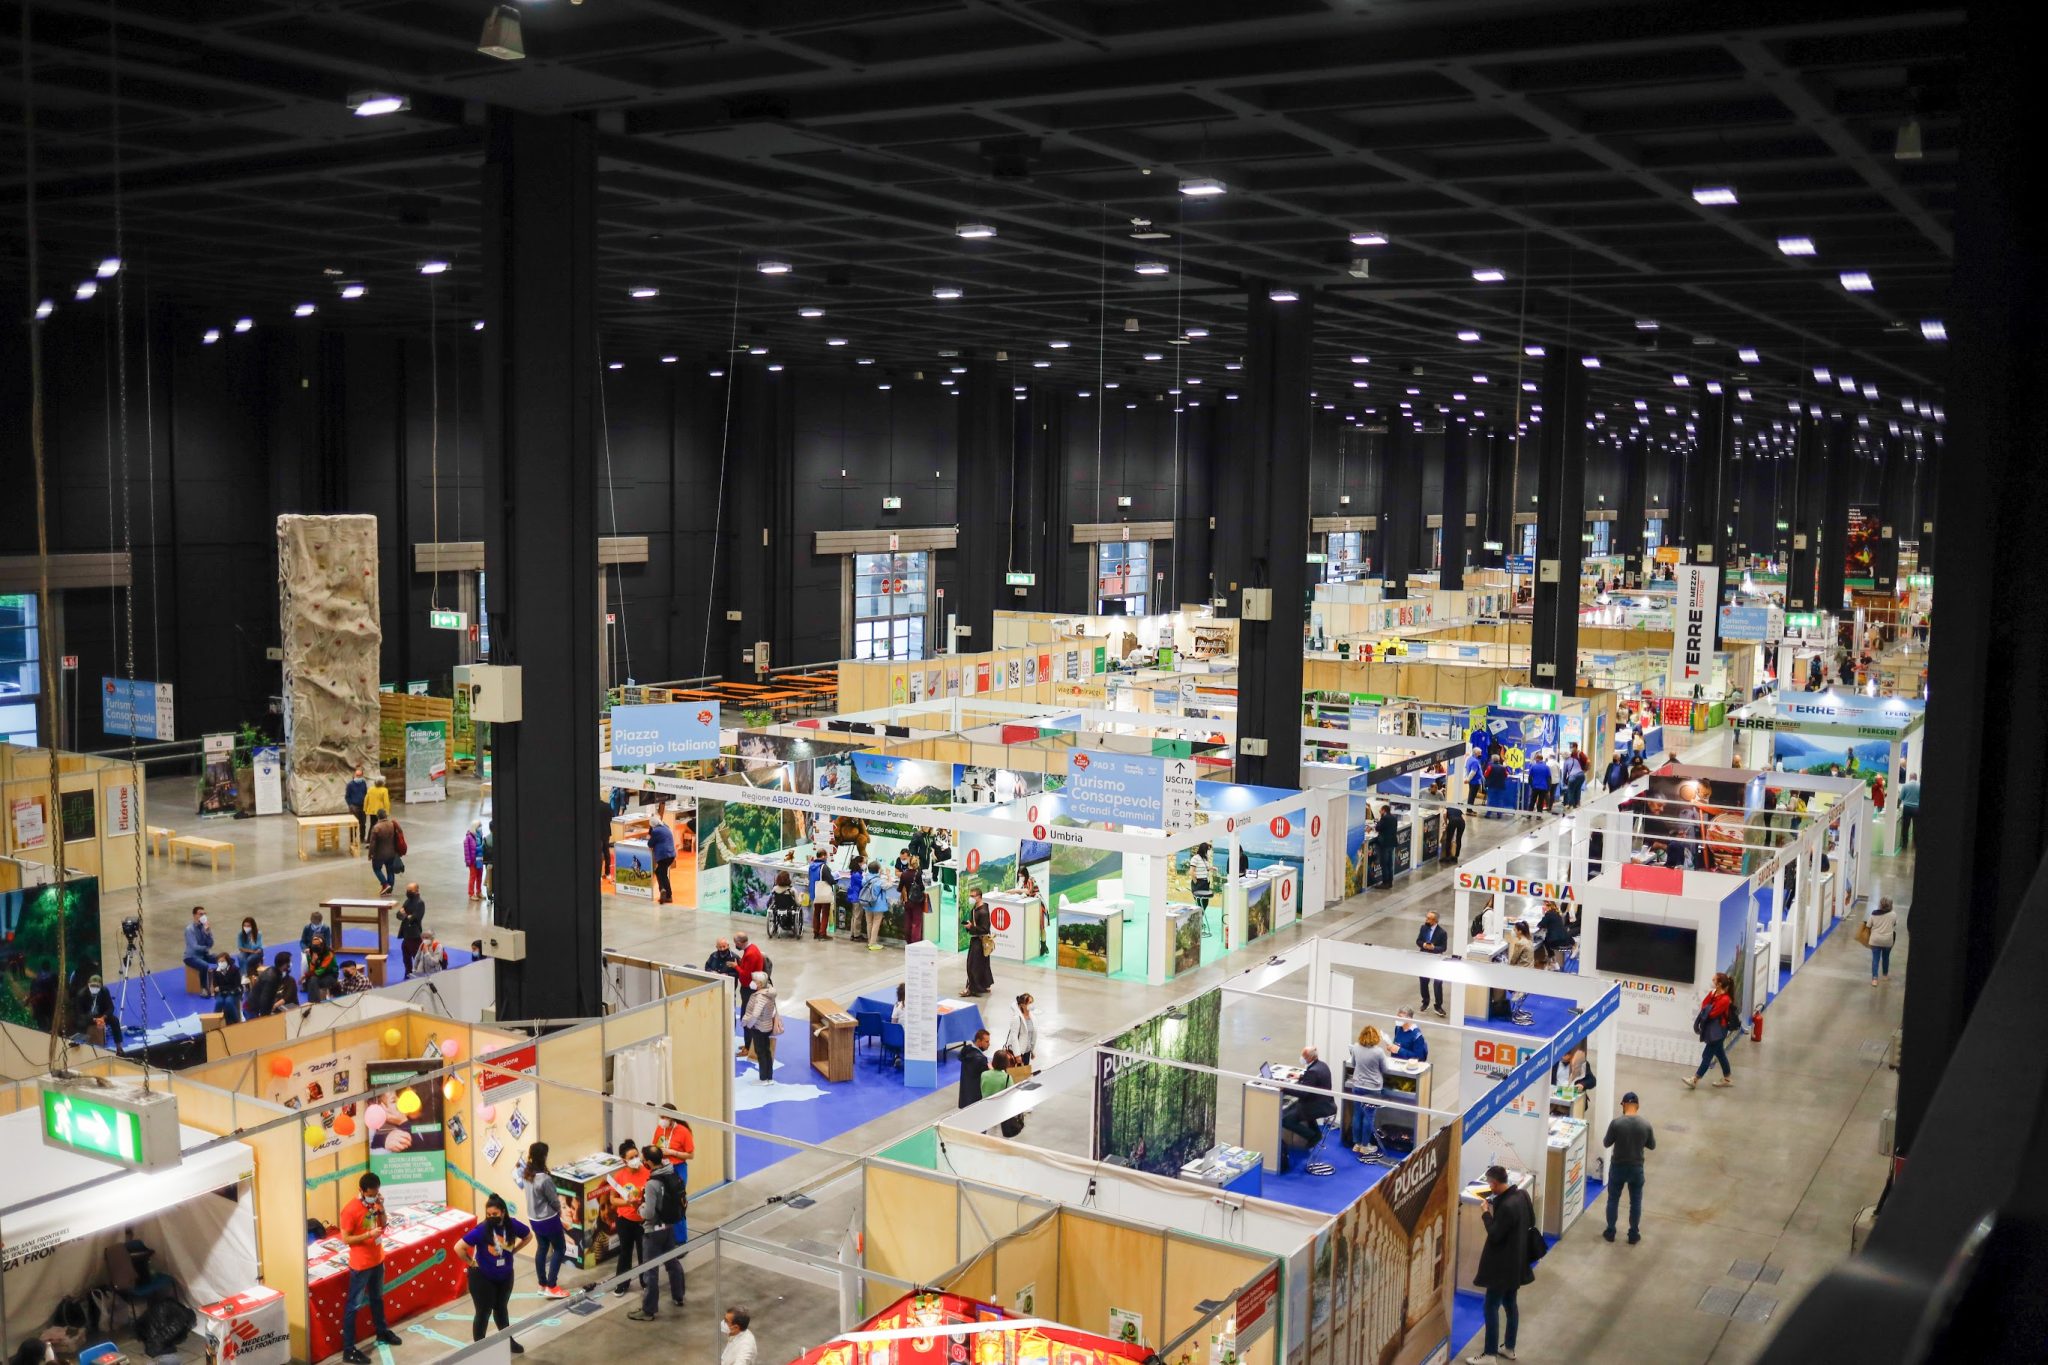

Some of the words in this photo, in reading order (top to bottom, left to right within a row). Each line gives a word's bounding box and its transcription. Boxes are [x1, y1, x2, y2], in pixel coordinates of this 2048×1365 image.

[1690, 597, 1695, 607] DI
[1685, 610, 1702, 679] TERRE
[1728, 717, 1774, 730] TERRE
[615, 730, 659, 741] Piazza
[1862, 728, 1897, 736] PERCORSI
[615, 742, 664, 757] Viaggio
[668, 740, 716, 752] Italiano
[1093, 762, 1109, 770] PAD
[1072, 774, 1125, 792] Turismo
[1165, 776, 1193, 785] USCITA
[741, 791, 771, 802] Regione
[814, 803, 836, 812] viaggio
[837, 805, 852, 813] nella
[853, 807, 876, 815] Natura
[888, 811, 909, 819] Parchi
[1071, 787, 1160, 809] Consapevole
[1080, 803, 1110, 816] Grandi
[1113, 808, 1155, 821] Cammini
[1050, 830, 1083, 843] Umbria
[1459, 873, 1575, 901] SARDEGNA
[1476, 1063, 1500, 1073] pugliesi
[1394, 1148, 1437, 1202] PUGLIA
[37, 1228, 70, 1243] FRONTIERES
[241, 1330, 276, 1347] MEDECINS
[236, 1344, 254, 1356] SANS
